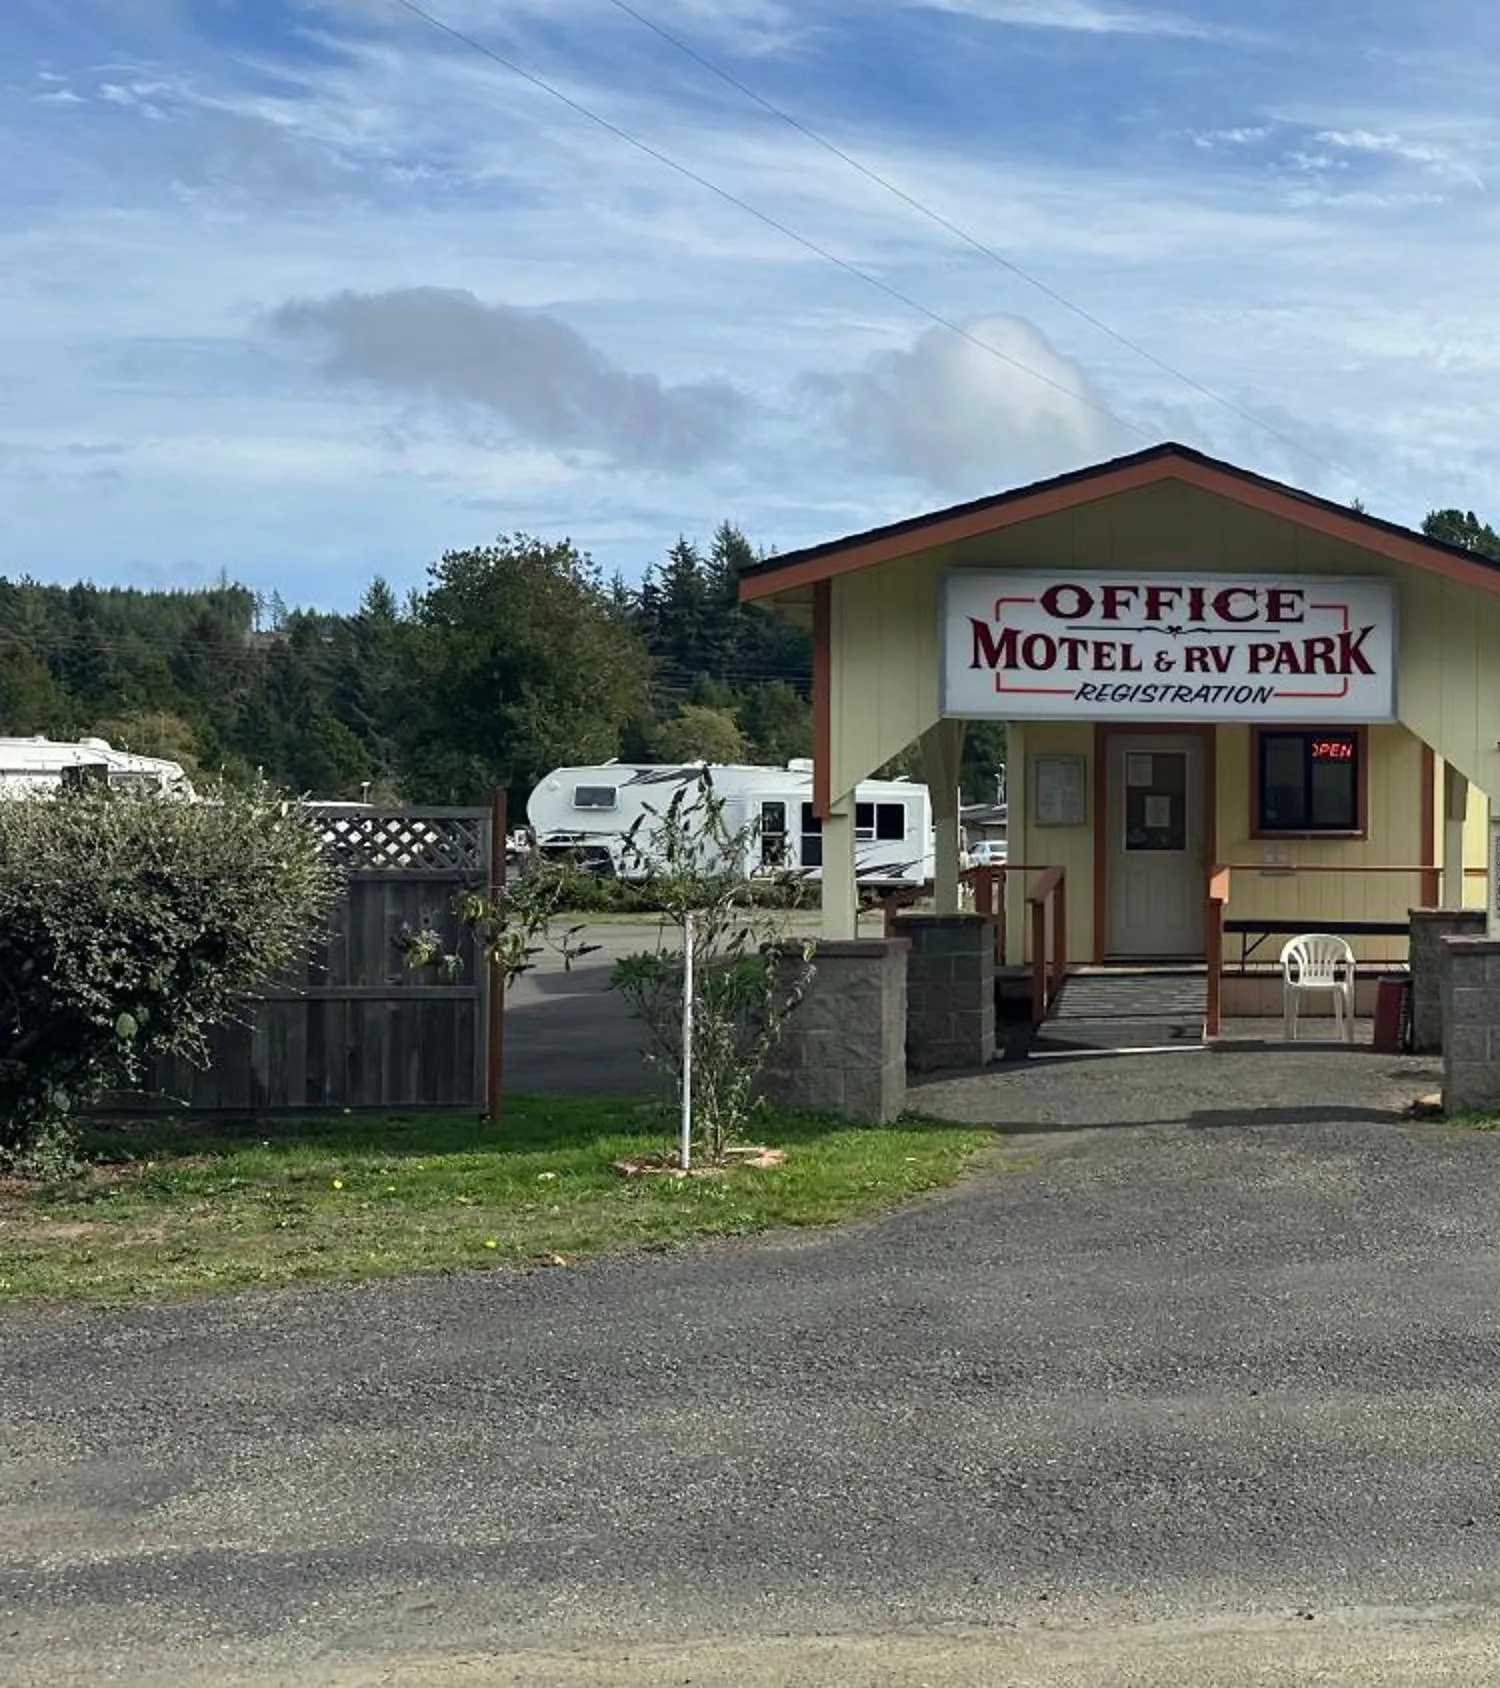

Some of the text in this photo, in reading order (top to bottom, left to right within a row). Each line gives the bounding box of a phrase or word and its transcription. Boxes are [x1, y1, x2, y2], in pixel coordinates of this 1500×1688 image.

[1039, 583, 1306, 624] OFFICE
[966, 616, 1377, 676] MOTEL & RV PARK
[1073, 682, 1276, 705] REGISTRATION
